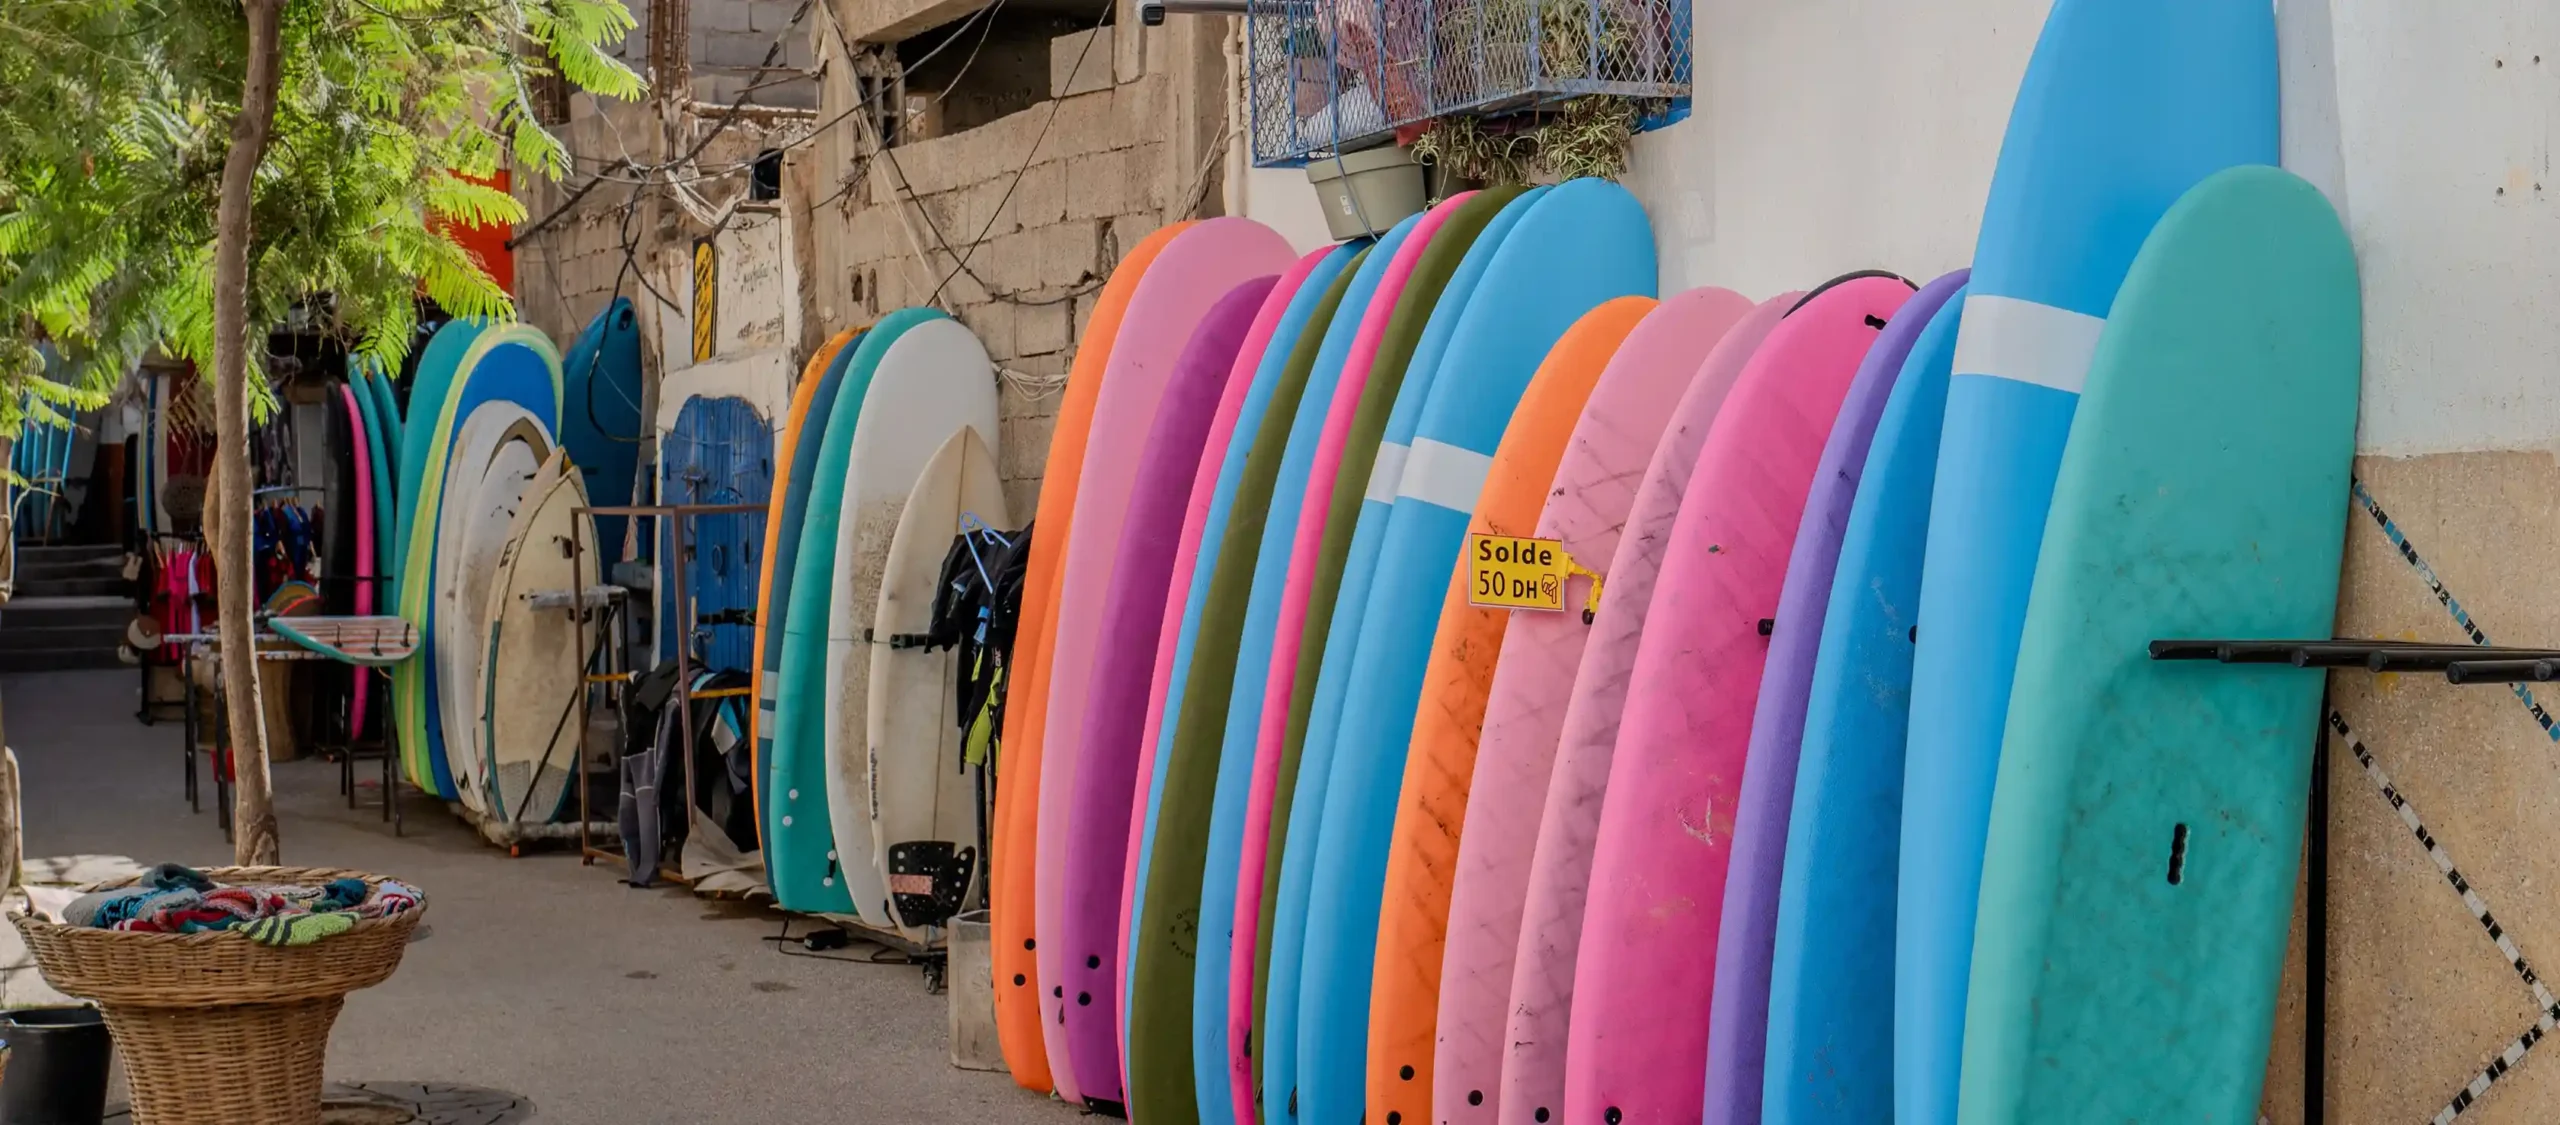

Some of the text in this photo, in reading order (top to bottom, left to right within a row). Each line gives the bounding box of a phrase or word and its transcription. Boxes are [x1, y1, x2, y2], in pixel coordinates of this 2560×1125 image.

[1479, 539, 1552, 566] Solde
[1479, 570, 1537, 599] 50 DH
